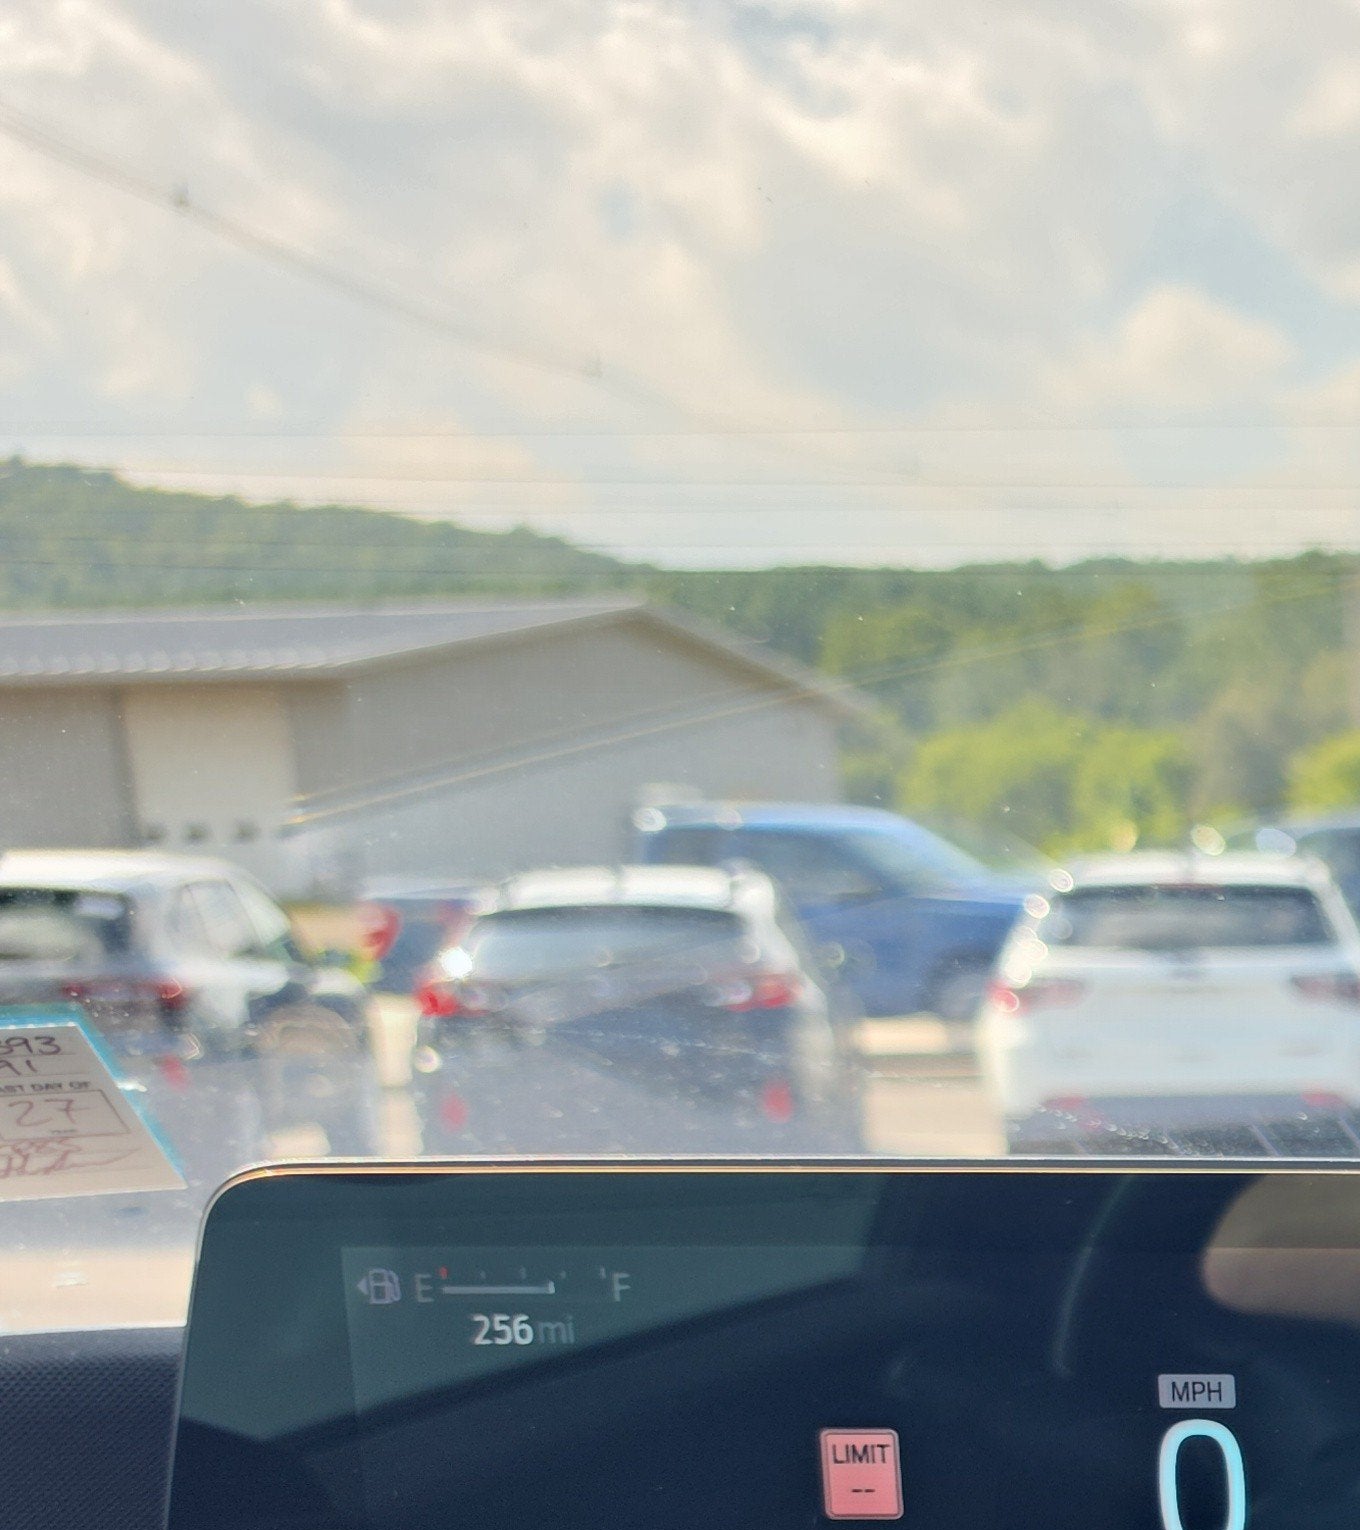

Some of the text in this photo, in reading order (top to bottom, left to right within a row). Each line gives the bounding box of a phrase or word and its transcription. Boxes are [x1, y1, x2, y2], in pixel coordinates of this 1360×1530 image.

[8, 1099, 80, 1127] 27
[415, 1274, 434, 1302] E
[612, 1272, 631, 1302] F
[471, 1314, 575, 1345] 256 mi
[1171, 1381, 1223, 1402] MPH
[832, 1444, 890, 1464] LIMIT
